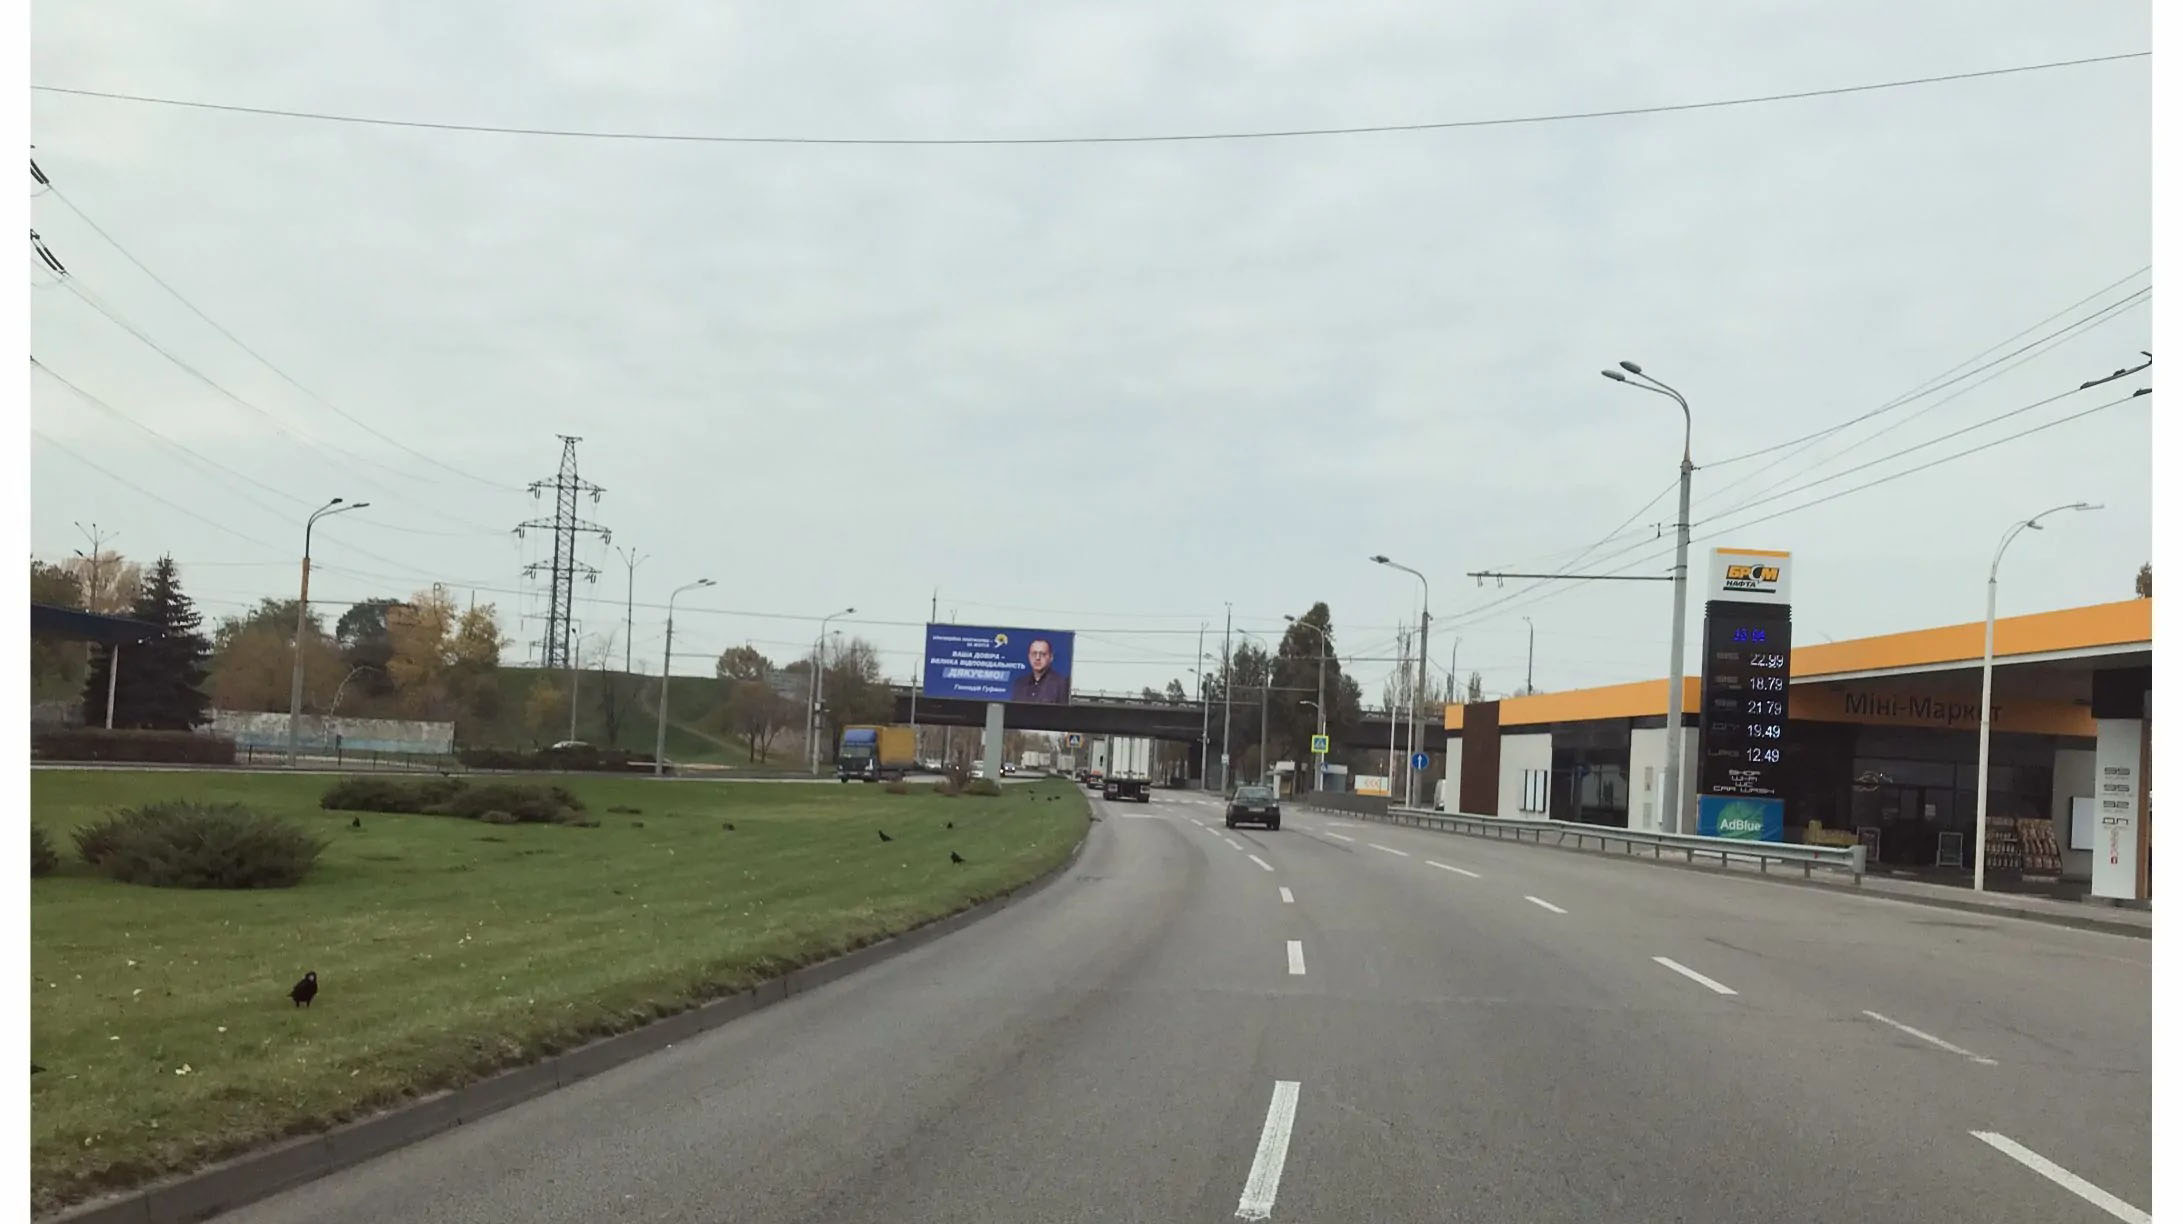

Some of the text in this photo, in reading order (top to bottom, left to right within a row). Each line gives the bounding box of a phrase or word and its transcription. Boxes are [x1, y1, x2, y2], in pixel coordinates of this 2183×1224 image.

[1750, 653, 1784, 668] 22.99
[1750, 676, 1783, 691] 18.79
[1844, 693, 2004, 725] Міні-Маркт
[1747, 723, 1781, 739] 19.49
[1746, 747, 1780, 763] 12.49
[1720, 818, 1762, 832] AdBlue
